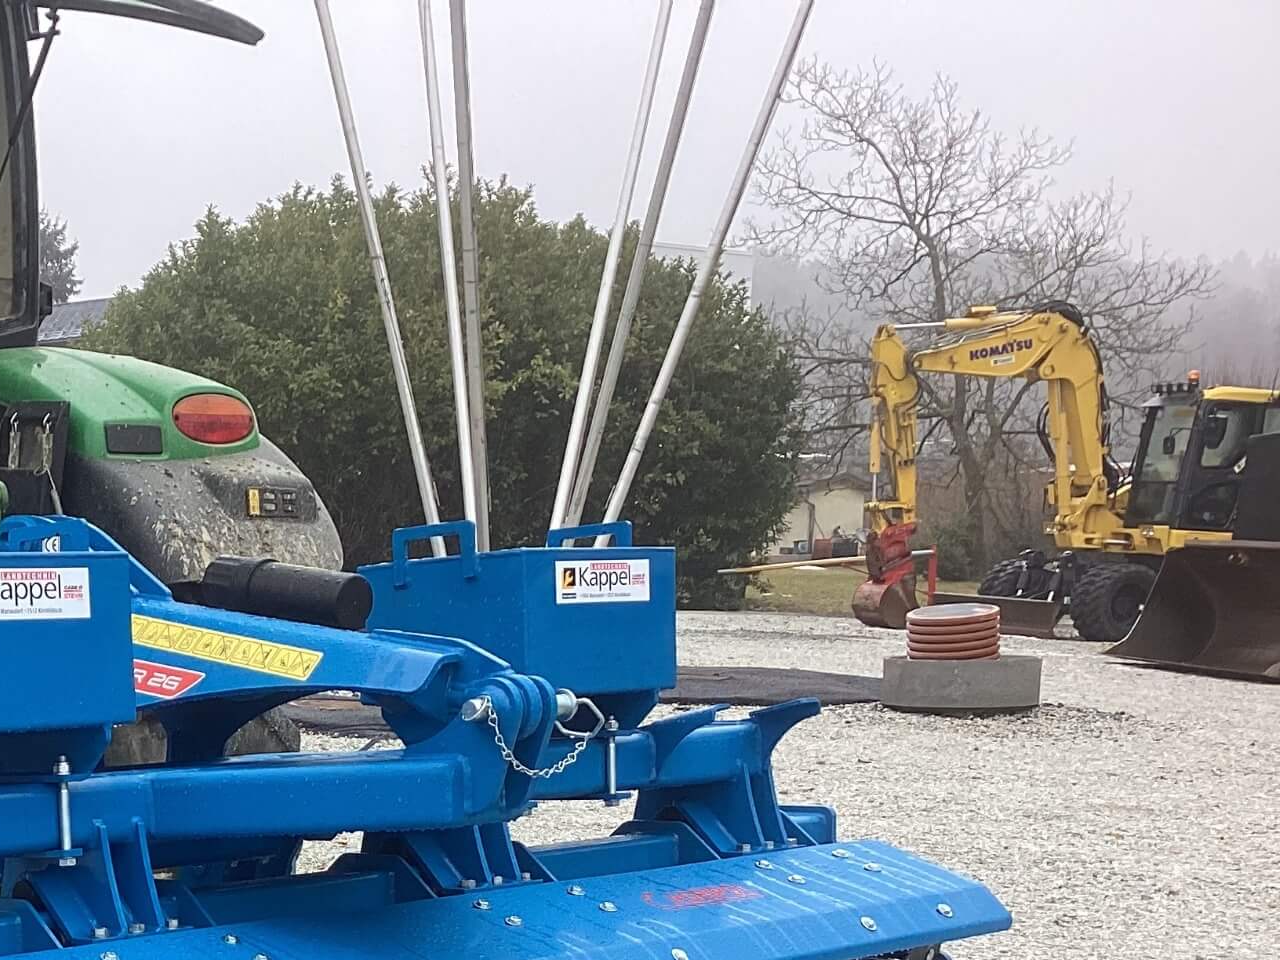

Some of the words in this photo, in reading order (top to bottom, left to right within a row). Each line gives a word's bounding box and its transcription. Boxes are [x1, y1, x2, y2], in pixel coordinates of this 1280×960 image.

[969, 338, 1033, 361] KOMATSU
[579, 564, 631, 592] Kappel
[147, 672, 183, 691] 26
